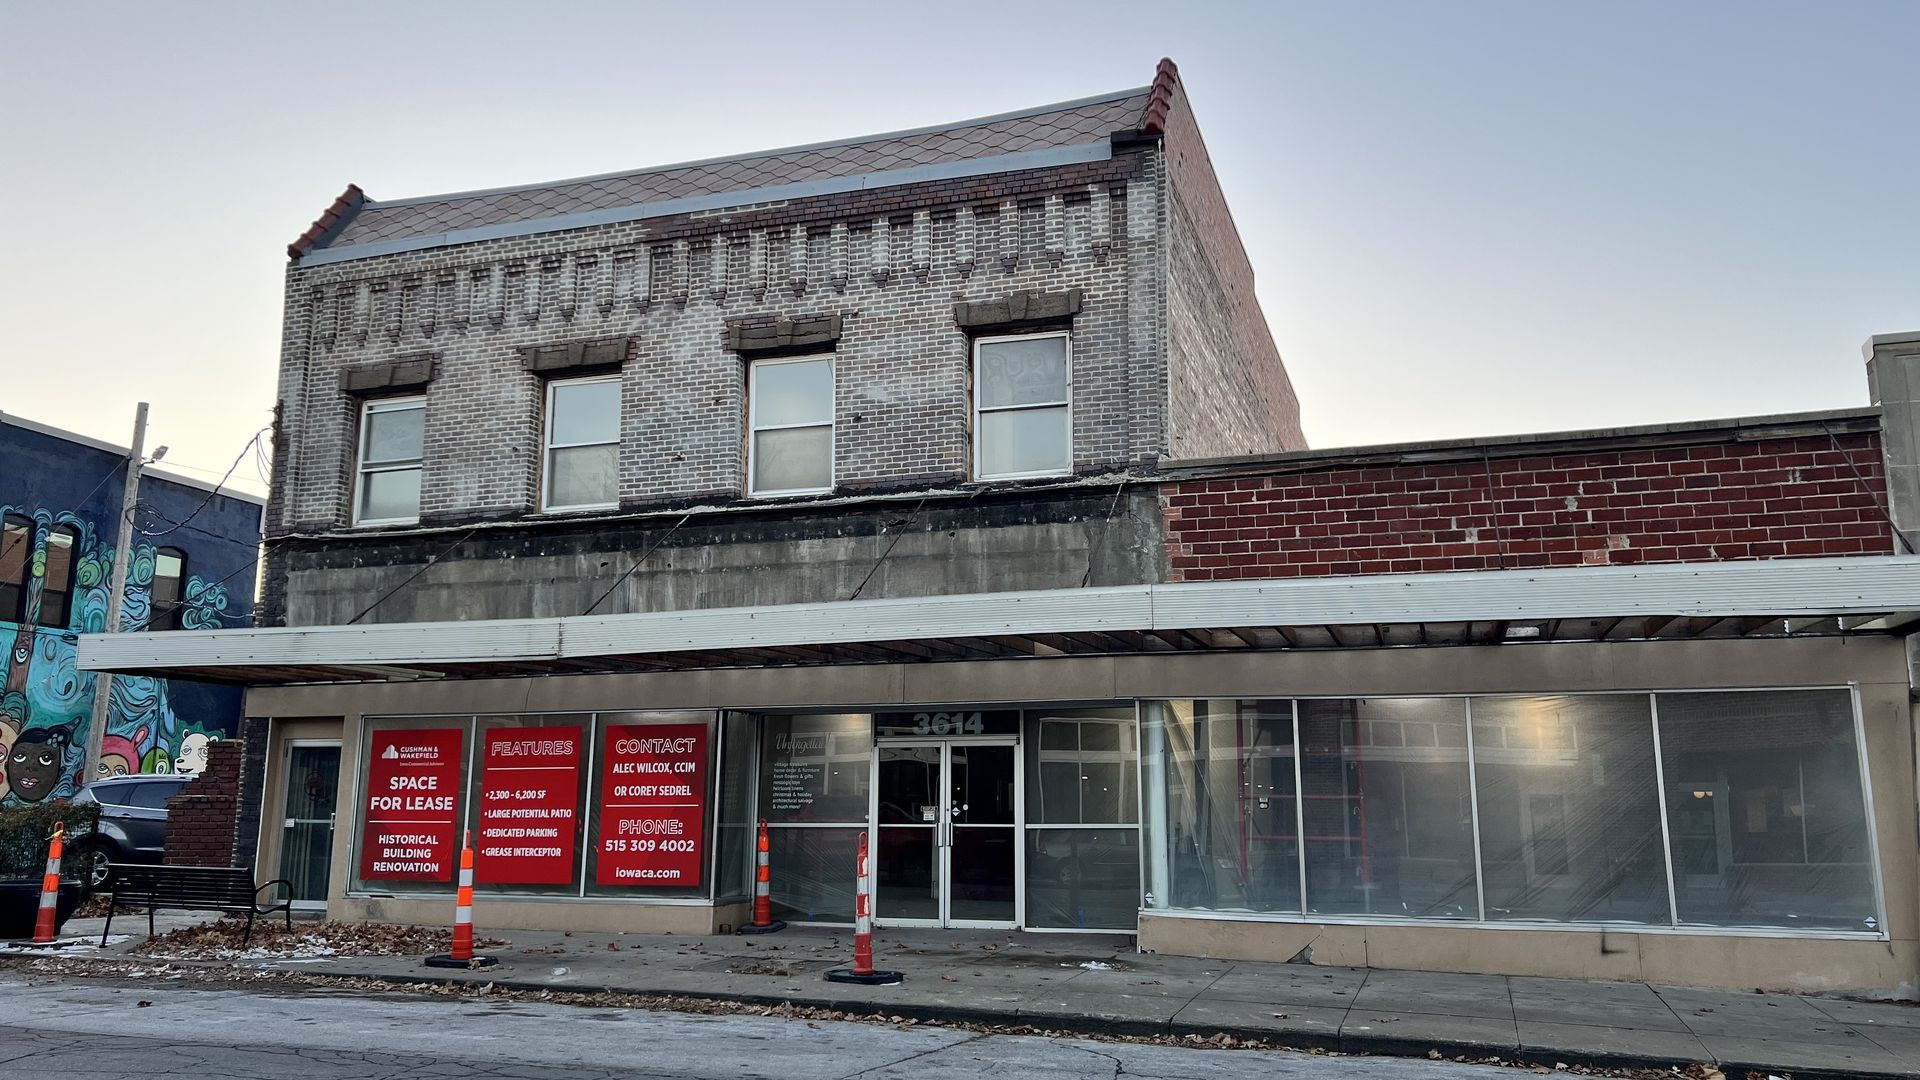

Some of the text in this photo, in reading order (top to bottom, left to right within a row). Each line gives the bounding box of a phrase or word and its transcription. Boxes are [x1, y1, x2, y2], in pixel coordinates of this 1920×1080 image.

[913, 712, 984, 735] 3614
[492, 740, 573, 756] FEATURES
[616, 738, 696, 754] CONTACT
[613, 762, 696, 775] ALEC WILCOX, CCIM
[390, 776, 437, 790] SPACE
[489, 791, 509, 800] 2,300
[516, 790, 536, 800] 6,200
[537, 790, 546, 799] SF
[614, 786, 692, 796] OR COREY SEDREL
[370, 797, 453, 810] FOR LEASE
[488, 809, 571, 818] LARGE POTENTIAL PATIO
[487, 828, 557, 837] DEDICATED PARKING
[619, 819, 683, 835] PHONE:
[378, 835, 438, 844] HISTORICAL
[606, 840, 694, 852] 515 309 4002
[383, 849, 431, 858] BUILDING
[486, 848, 561, 856] GREASE INTERCEPTOR
[373, 862, 439, 872] RENOVATION
[616, 867, 680, 878] iowaca.com
